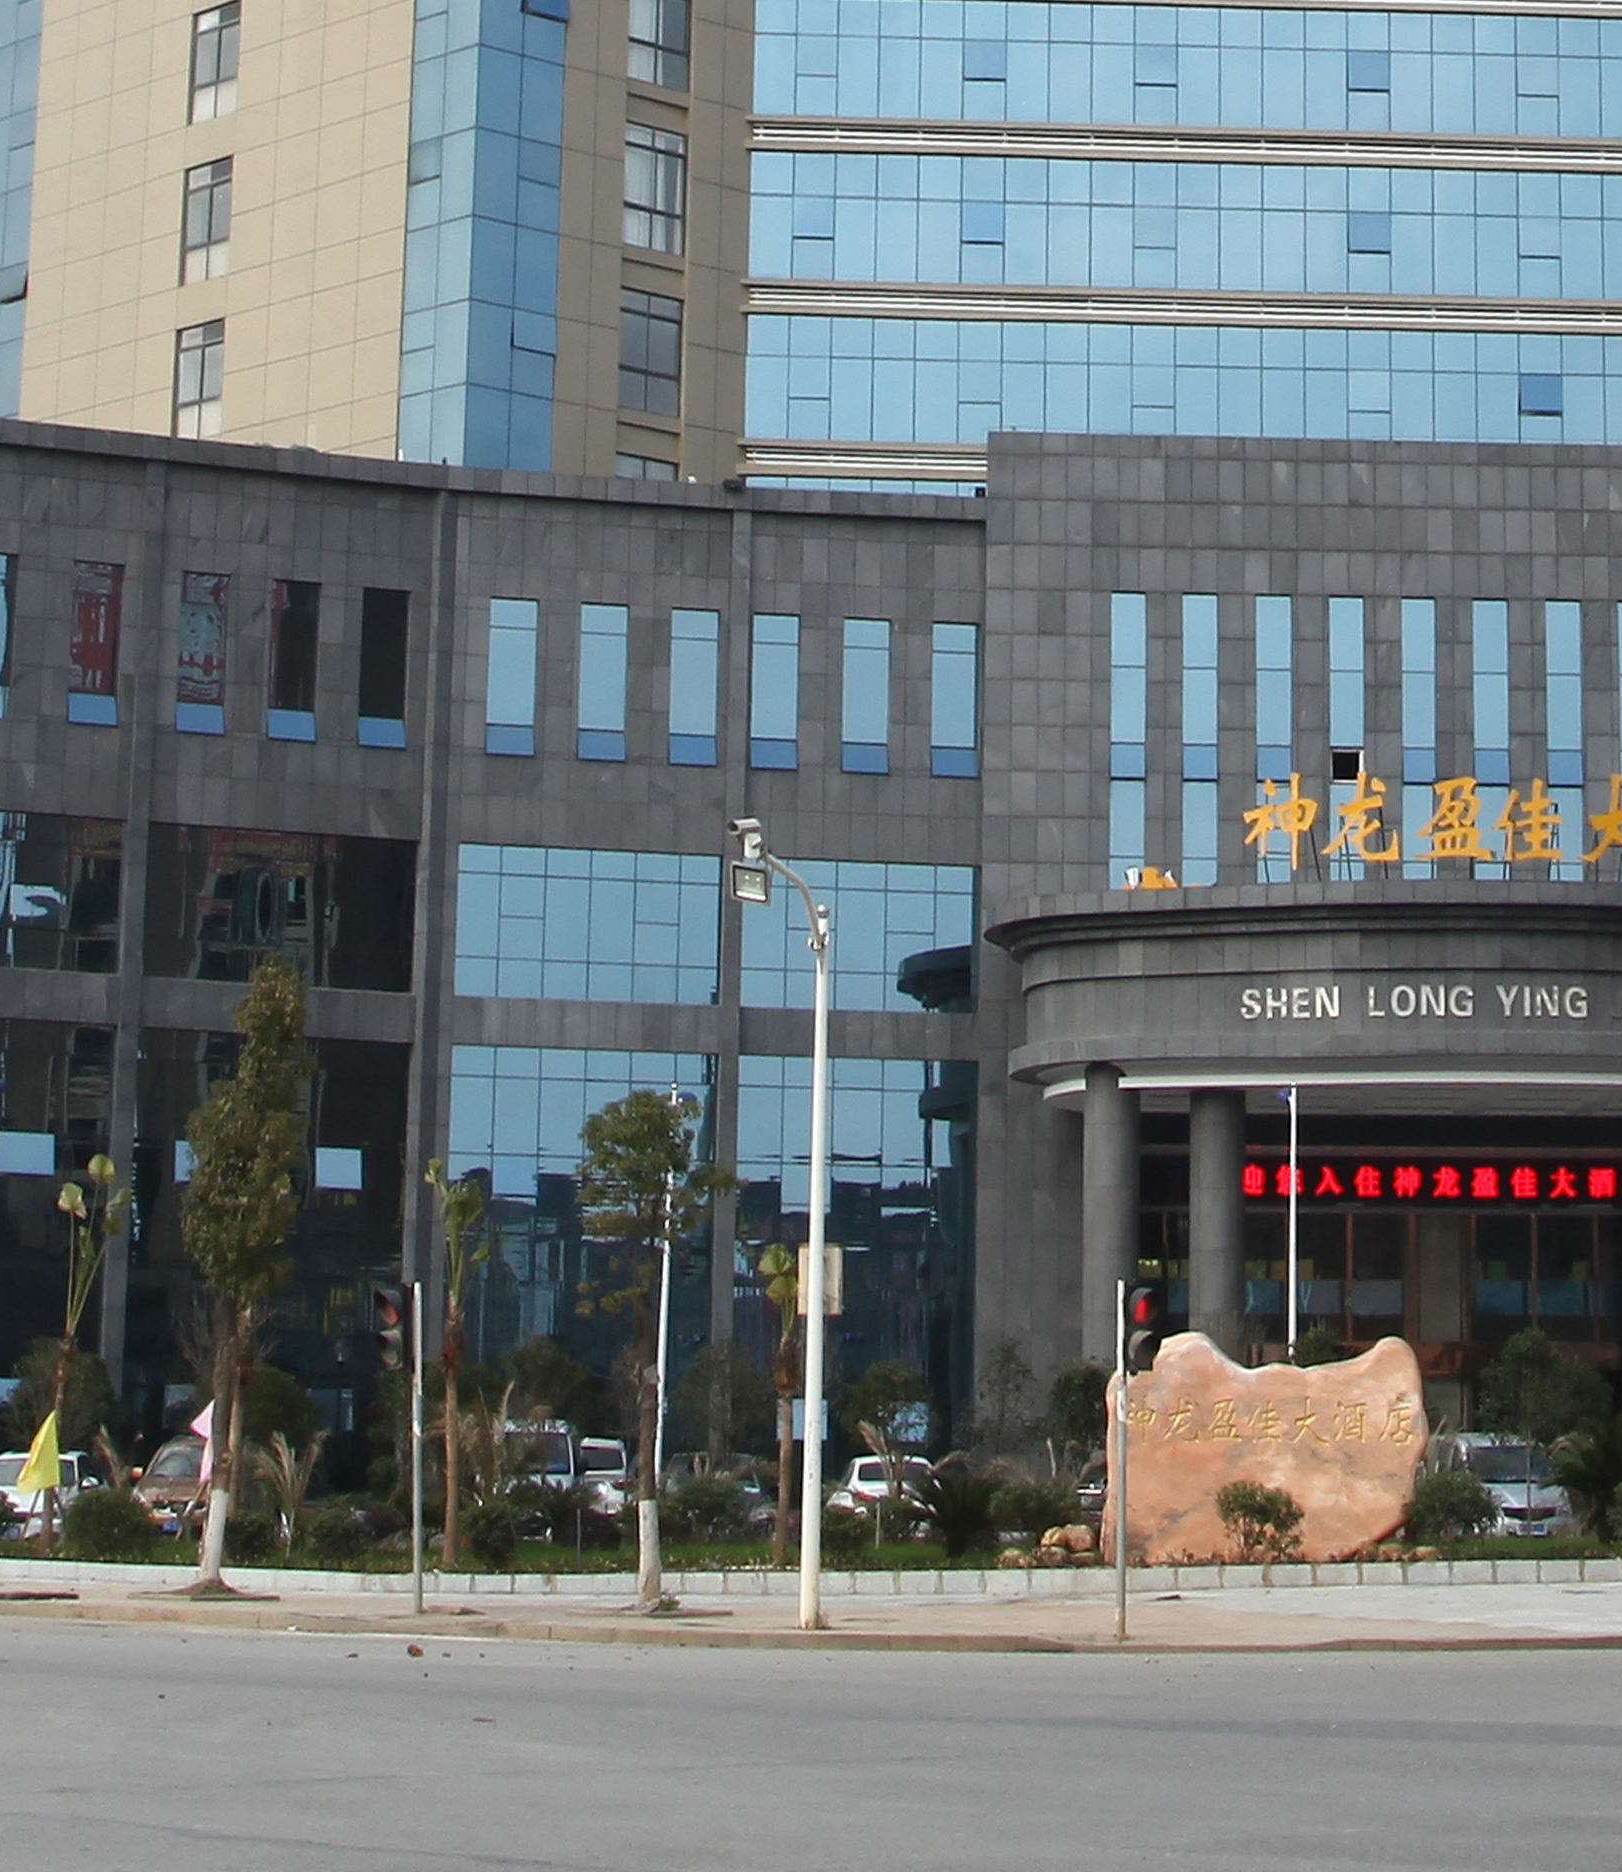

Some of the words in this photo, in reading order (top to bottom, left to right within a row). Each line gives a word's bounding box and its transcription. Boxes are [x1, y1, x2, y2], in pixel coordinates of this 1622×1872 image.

[1240, 985, 1340, 1021] SHEN
[1368, 984, 1474, 1018] LONG
[1496, 985, 1588, 1019] YING
[1126, 1396, 1415, 1446] 神龙盈佳大酒店
